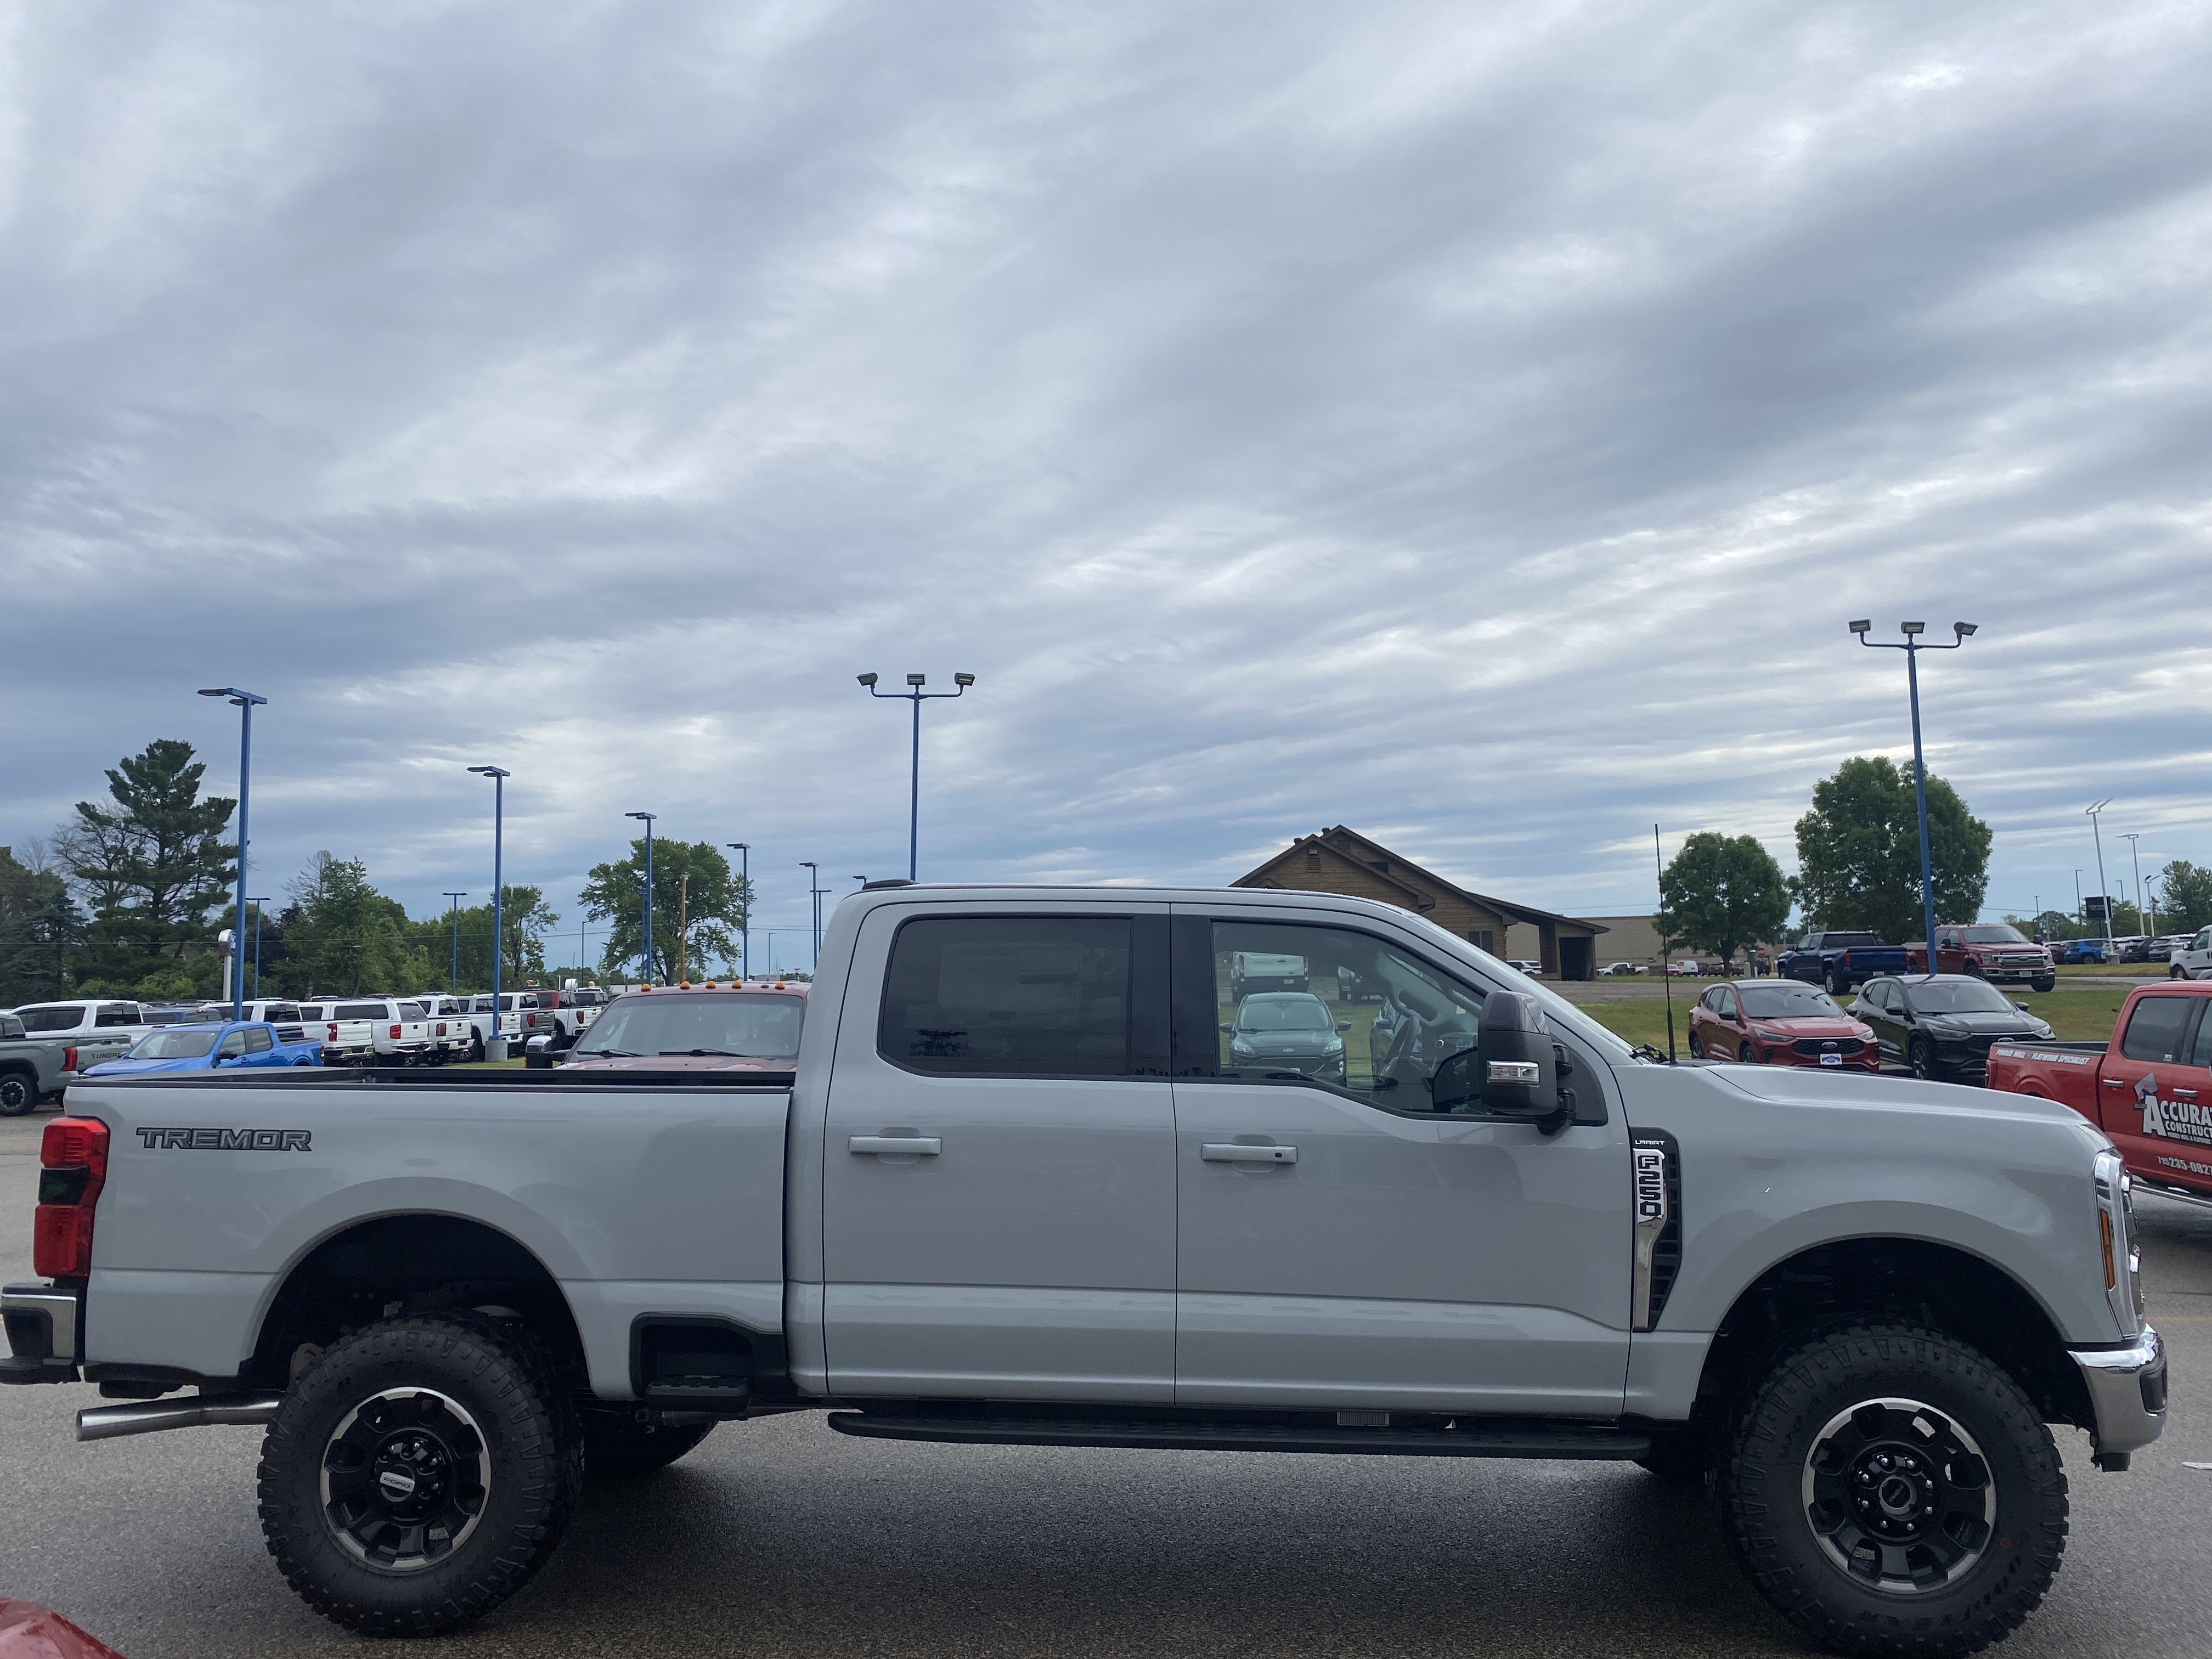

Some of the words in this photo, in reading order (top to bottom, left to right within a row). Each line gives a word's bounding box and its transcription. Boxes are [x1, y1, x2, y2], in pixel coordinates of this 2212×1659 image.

[2031, 1053, 2059, 1062] FLATWORK
[2058, 1055, 2091, 1065] SPECIALIST
[2143, 1095, 2212, 1137] ACCURA
[136, 1127, 312, 1152] TREMOR
[1638, 1155, 1661, 1216] F250
[383, 1477, 410, 1488] FORD
